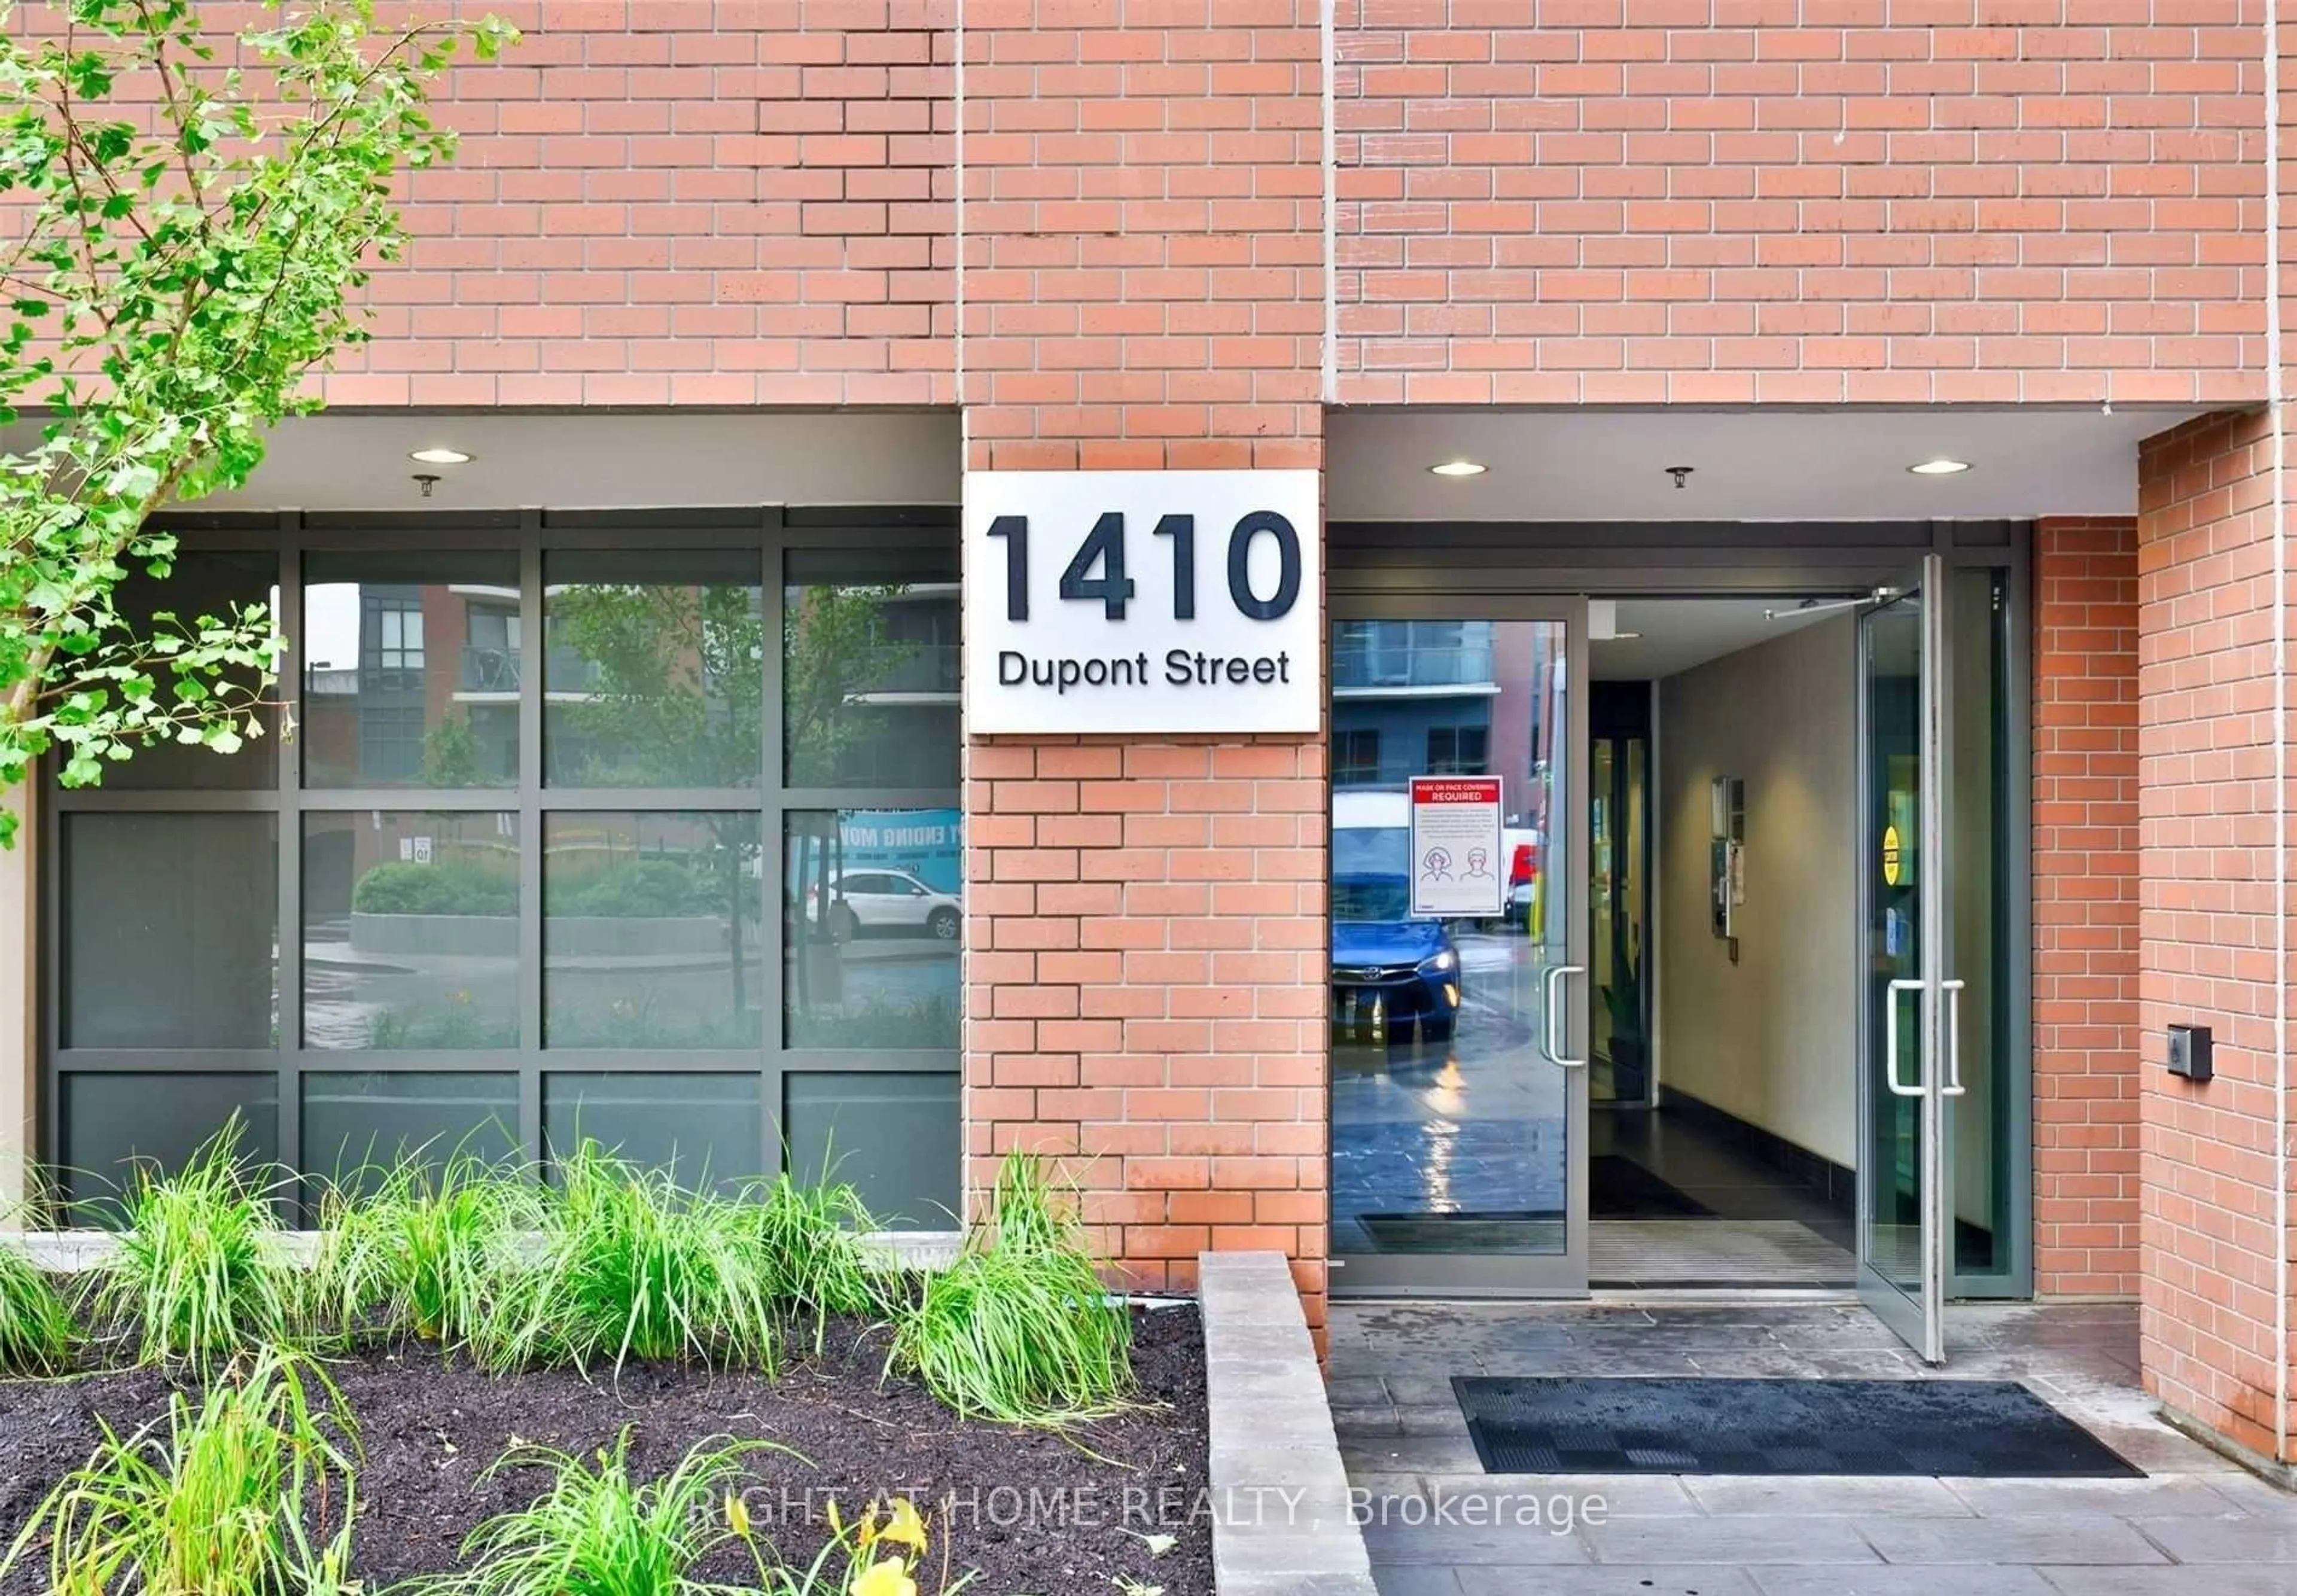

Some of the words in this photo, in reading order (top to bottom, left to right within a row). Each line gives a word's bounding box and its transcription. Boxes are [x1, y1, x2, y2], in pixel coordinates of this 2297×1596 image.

[986, 511, 1302, 622] 1410
[998, 650, 1148, 695] Dupont
[1165, 648, 1290, 686] Street
[1432, 791, 1482, 801] REQUIRED
